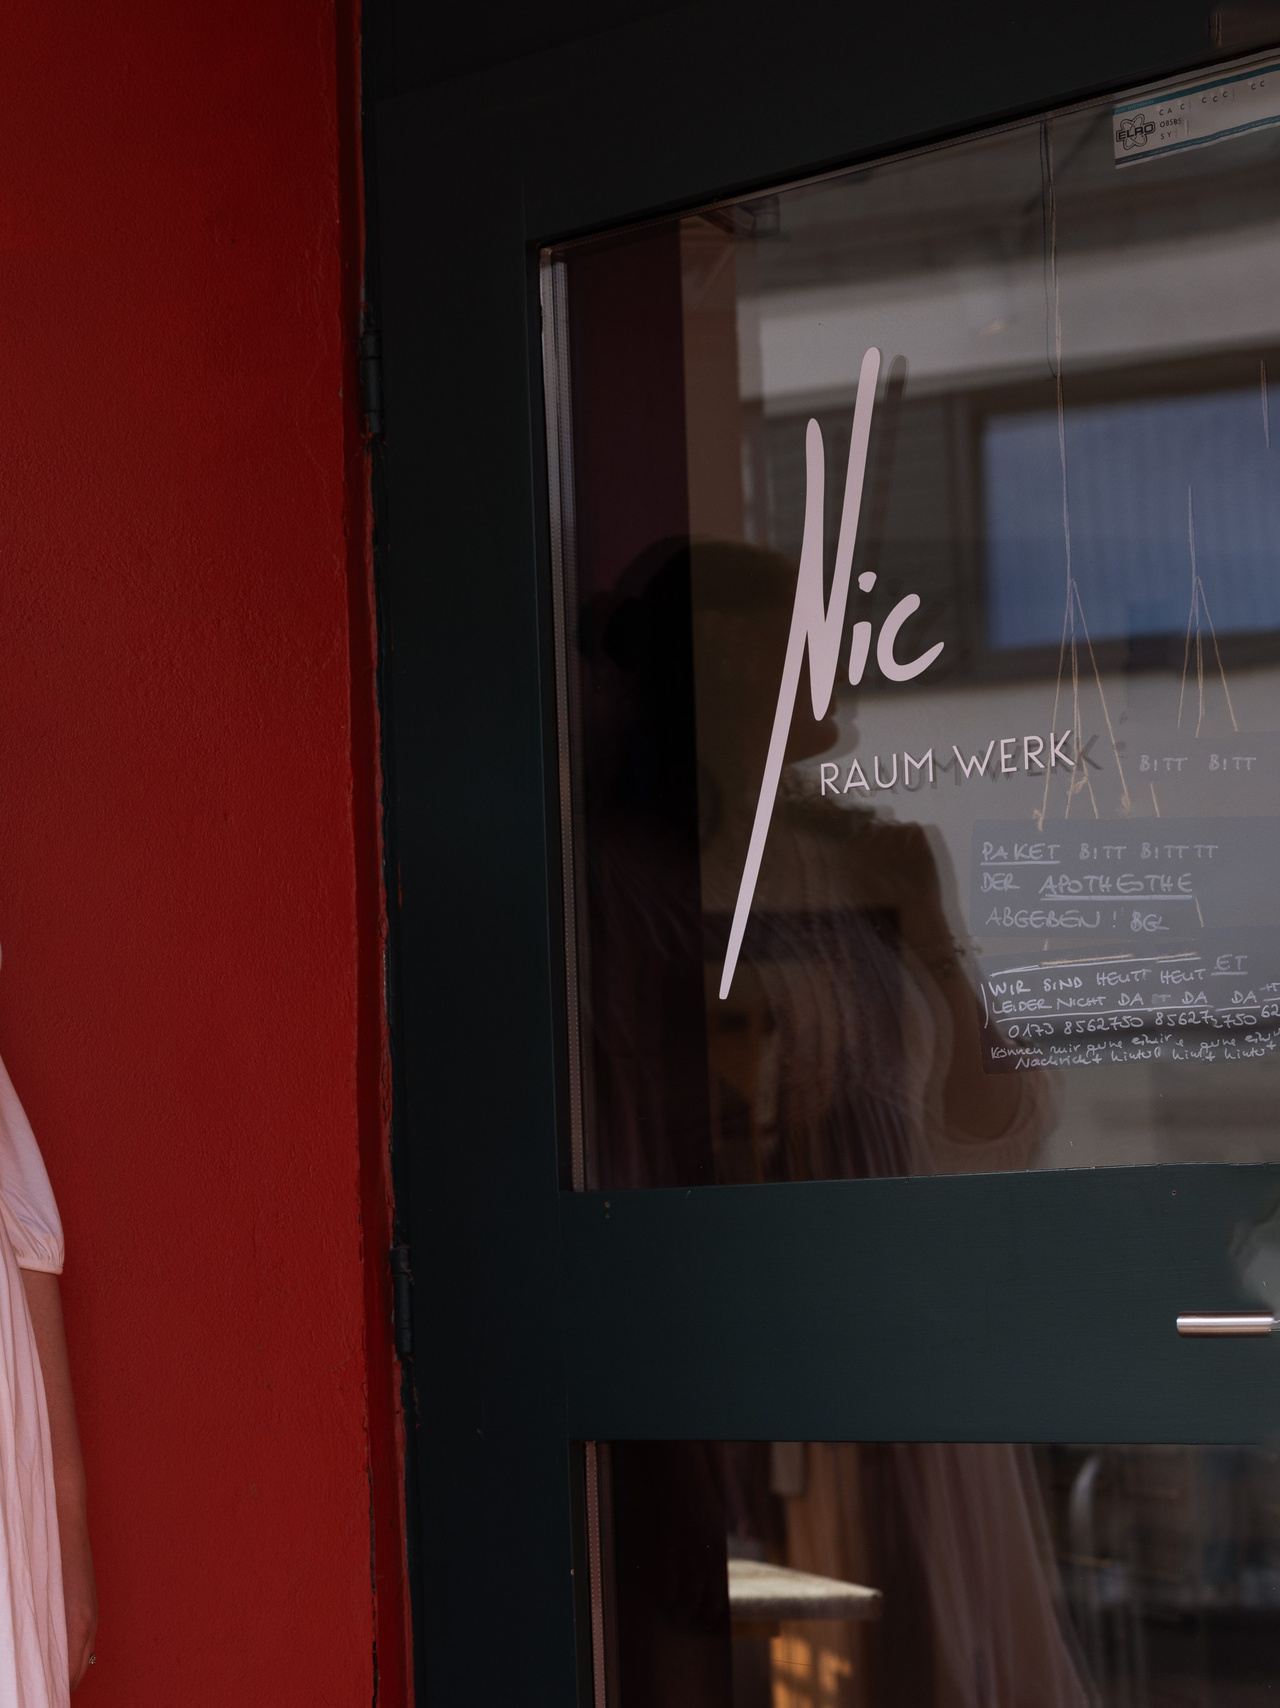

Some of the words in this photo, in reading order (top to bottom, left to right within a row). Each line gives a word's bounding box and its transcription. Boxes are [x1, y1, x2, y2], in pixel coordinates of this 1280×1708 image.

[719, 346, 944, 1000] Nic
[820, 747, 933, 796] RAUM
[952, 729, 1075, 779] WERK
[981, 841, 1061, 861] PAKET
[980, 872, 1020, 893] DER
[988, 980, 1032, 997] WIR
[992, 998, 1053, 1015] LEIDER
[1117, 992, 1144, 1007] DA
[1181, 990, 1208, 1005] DA
[1231, 989, 1258, 1004] DA
[1008, 1022, 1055, 1039] 0173
